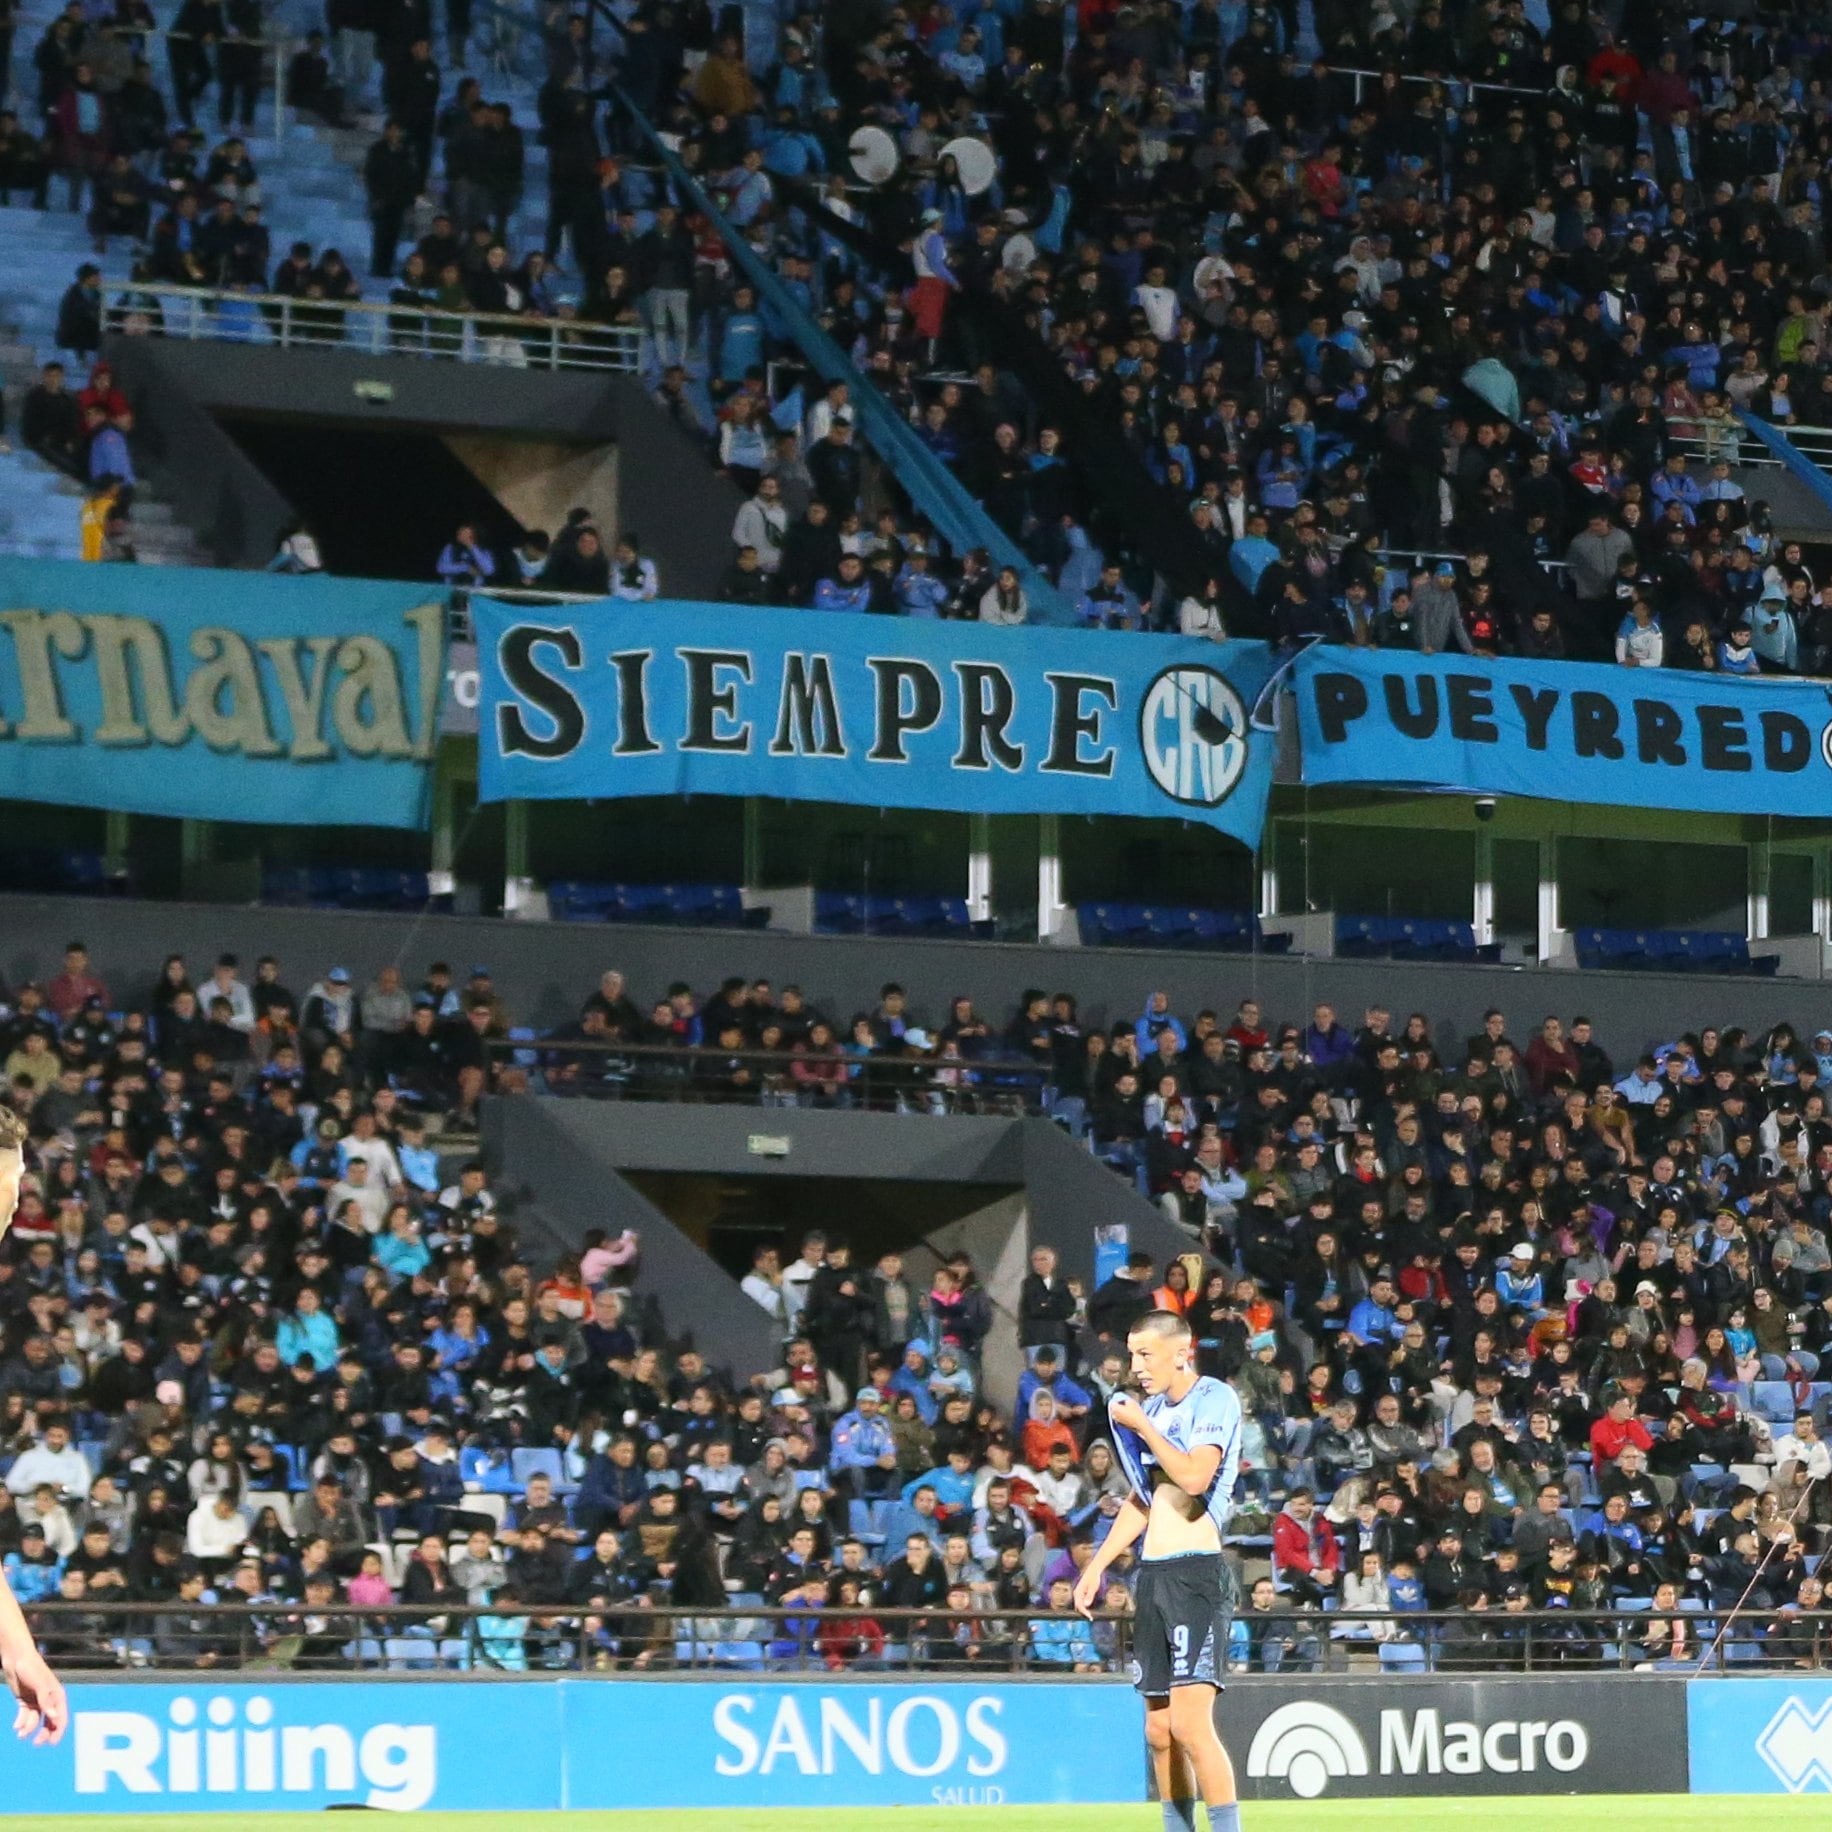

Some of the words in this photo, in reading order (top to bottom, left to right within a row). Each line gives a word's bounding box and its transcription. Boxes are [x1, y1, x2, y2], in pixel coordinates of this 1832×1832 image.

[0, 604, 446, 764] rnaval
[496, 622, 1118, 778] SIEMPRE
[1173, 1624, 1189, 1658] 9
[74, 1697, 436, 1811] Riiing
[713, 1695, 1007, 1777] SANOS
[1380, 1708, 1588, 1775] Macro
[931, 1786, 1003, 1806] SALUD
